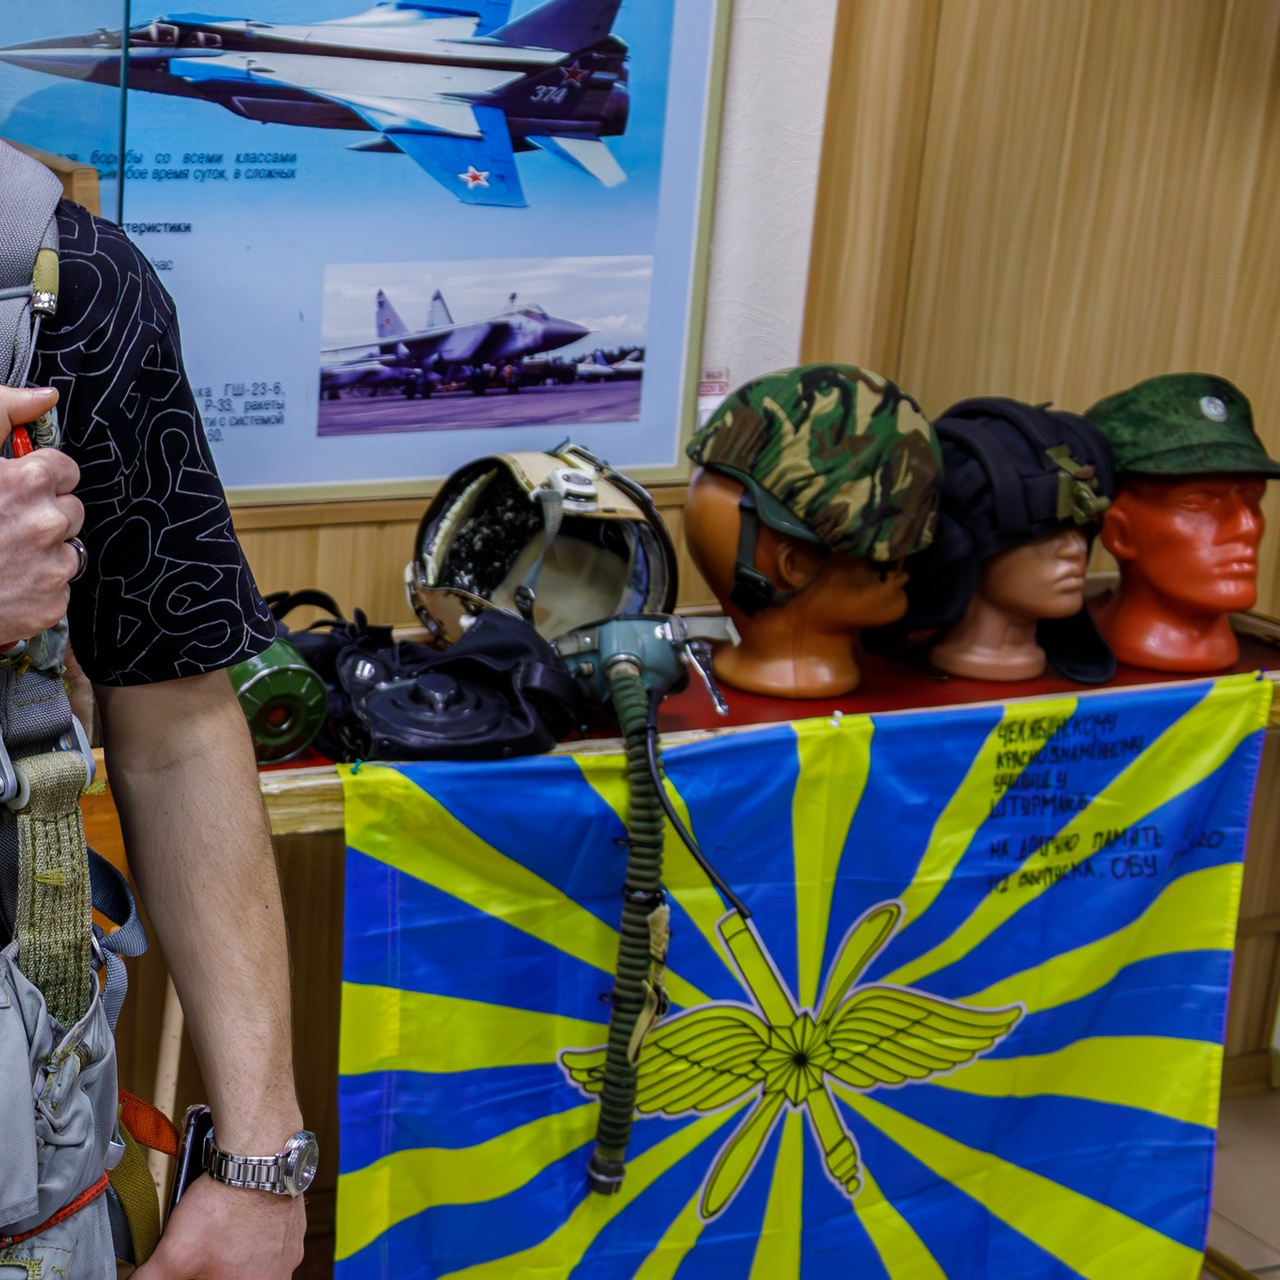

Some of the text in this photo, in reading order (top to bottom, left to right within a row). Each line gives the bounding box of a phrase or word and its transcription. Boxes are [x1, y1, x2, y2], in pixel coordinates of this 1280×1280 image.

[530, 85, 569, 104] 374
[183, 152, 297, 163] всеми классами
[152, 167, 296, 181] время сложных
[244, 400, 285, 413] ракеты
[229, 412, 284, 426] системой
